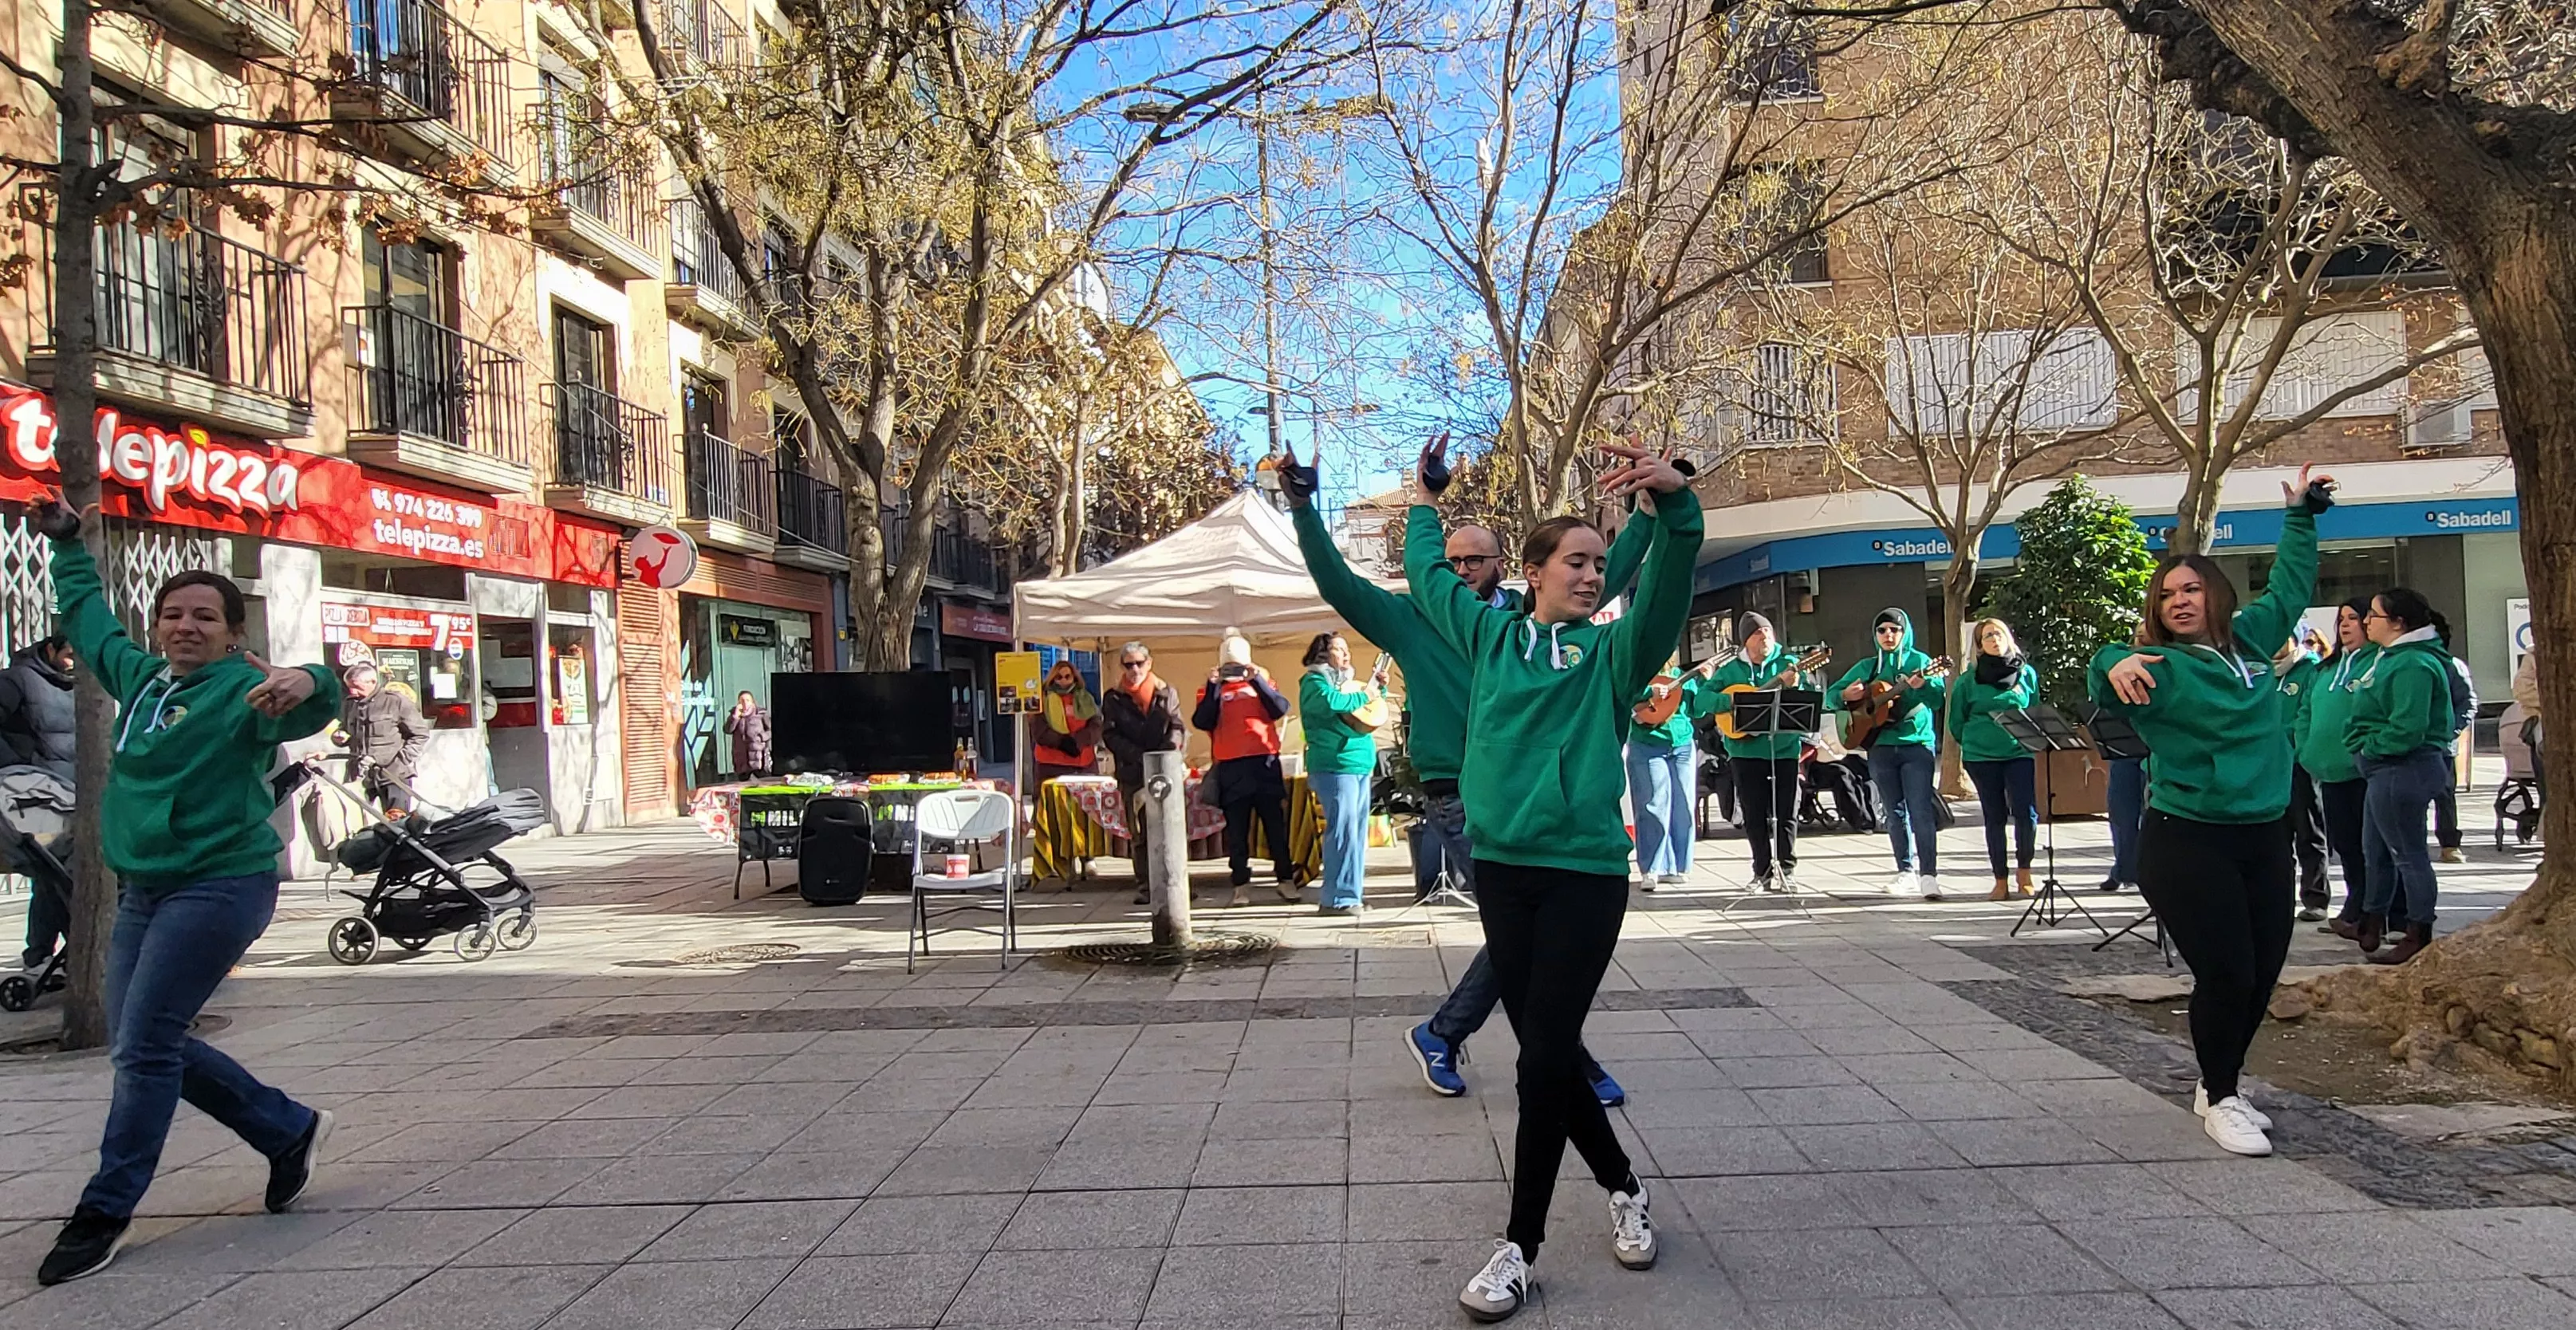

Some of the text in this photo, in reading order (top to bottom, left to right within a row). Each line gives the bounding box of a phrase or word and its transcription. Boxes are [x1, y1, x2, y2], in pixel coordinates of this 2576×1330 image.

[10, 399, 298, 511] tlepizza
[394, 493, 483, 529] 974 226 399
[2437, 510, 2511, 527] Sabadell
[373, 518, 484, 558] telepizza.es
[1884, 539, 1954, 557] Sabadel
